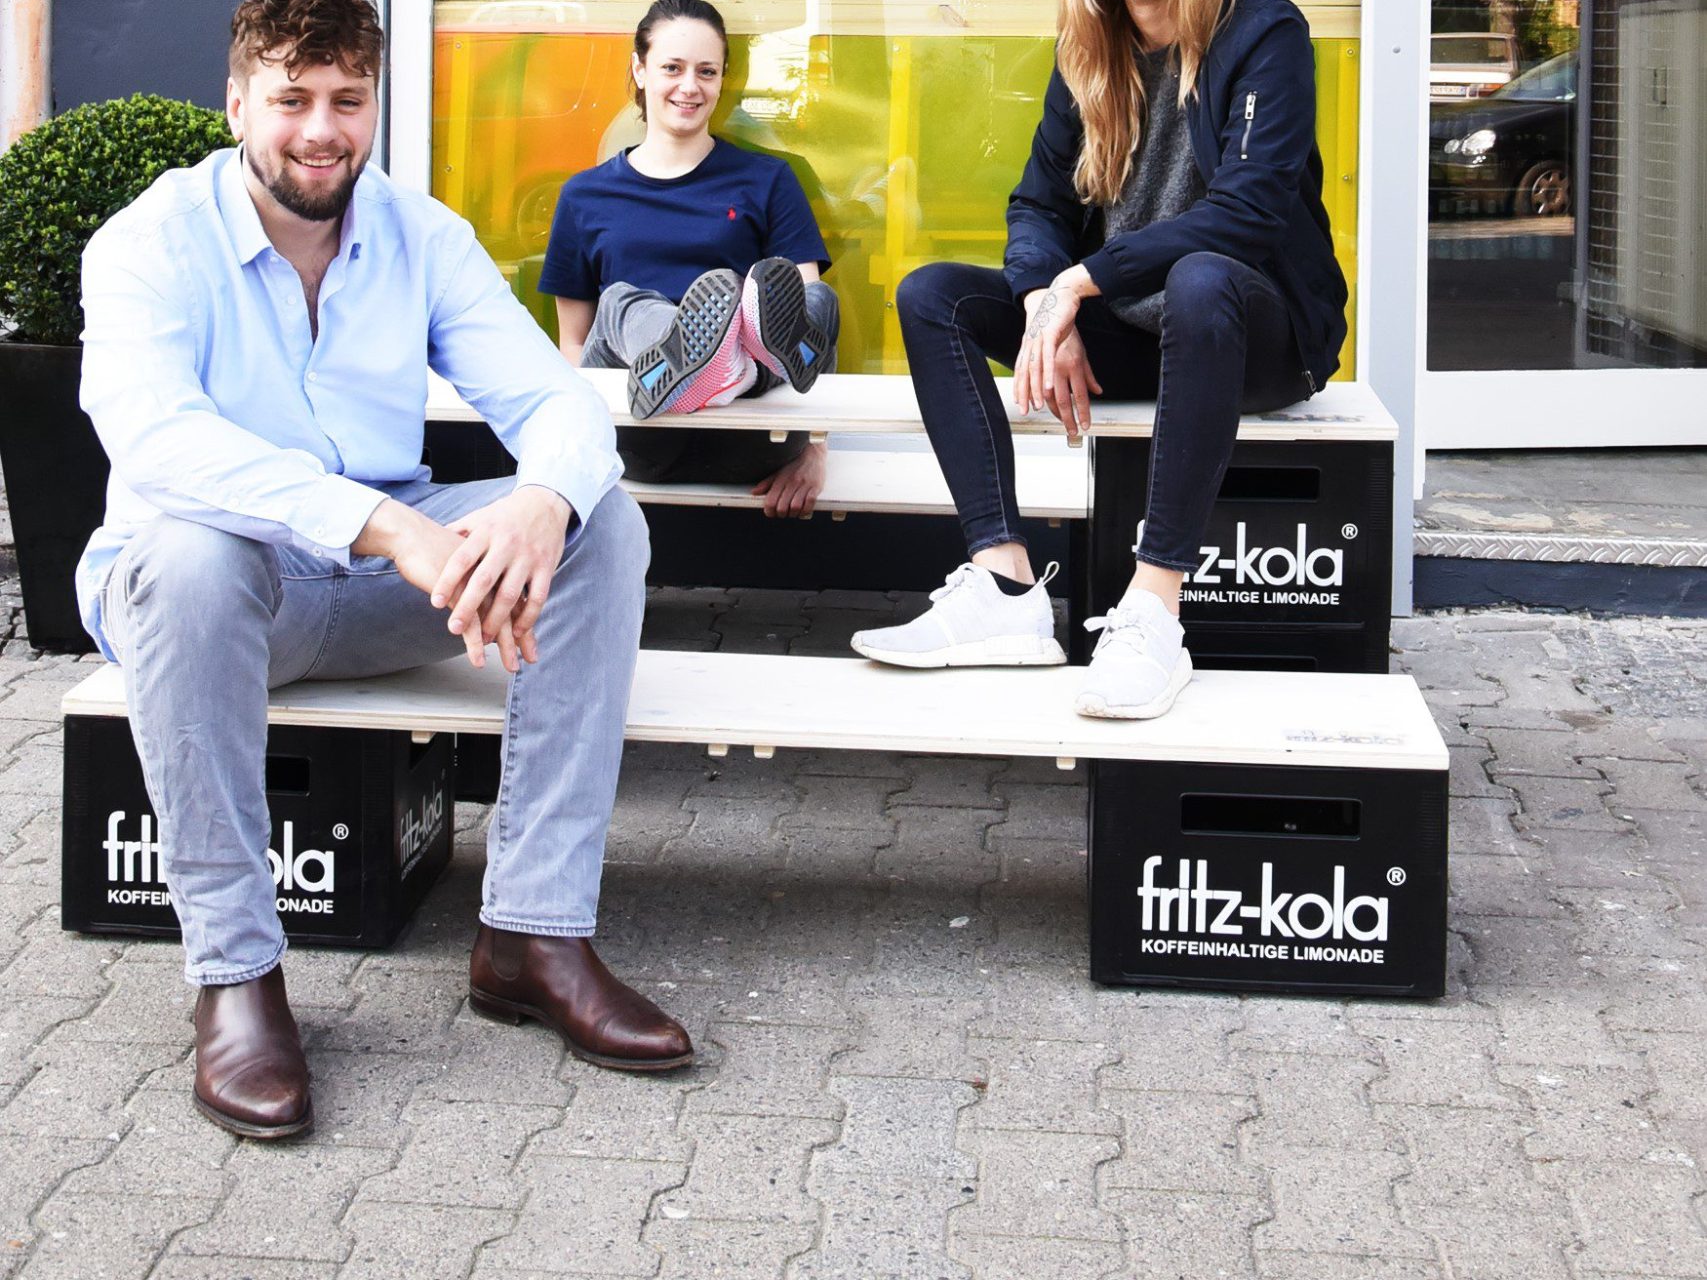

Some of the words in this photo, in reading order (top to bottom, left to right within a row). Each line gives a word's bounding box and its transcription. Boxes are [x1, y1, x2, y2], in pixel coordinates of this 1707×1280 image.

[1178, 589, 1260, 604] INHALTIGE
[1263, 591, 1340, 605] LIMONADE
[107, 889, 173, 906] KOFFEIN
[276, 897, 334, 914] ONADE
[1137, 855, 1389, 941] fritz-kola
[1141, 938, 1289, 960] KOFFEINHALTIGE
[1293, 939, 1385, 964] LIMONADE
